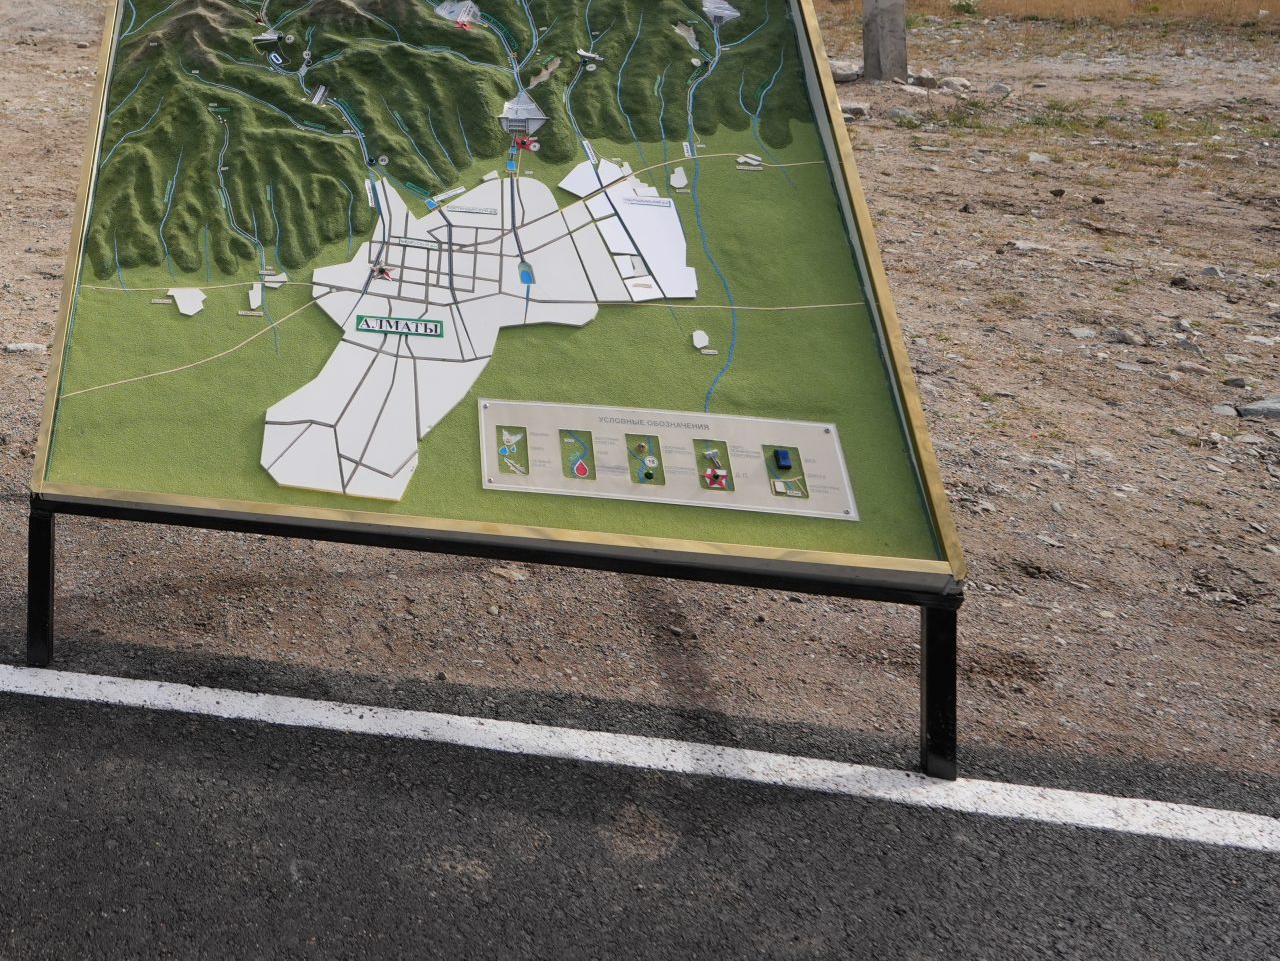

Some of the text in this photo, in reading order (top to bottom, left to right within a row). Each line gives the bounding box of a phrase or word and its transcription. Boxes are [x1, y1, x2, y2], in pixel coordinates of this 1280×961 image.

[360, 318, 439, 334] АЛМАТЫ
[598, 416, 710, 431] УСЛОВНЫЕ ОБОЗНАЧЕНИЯ
